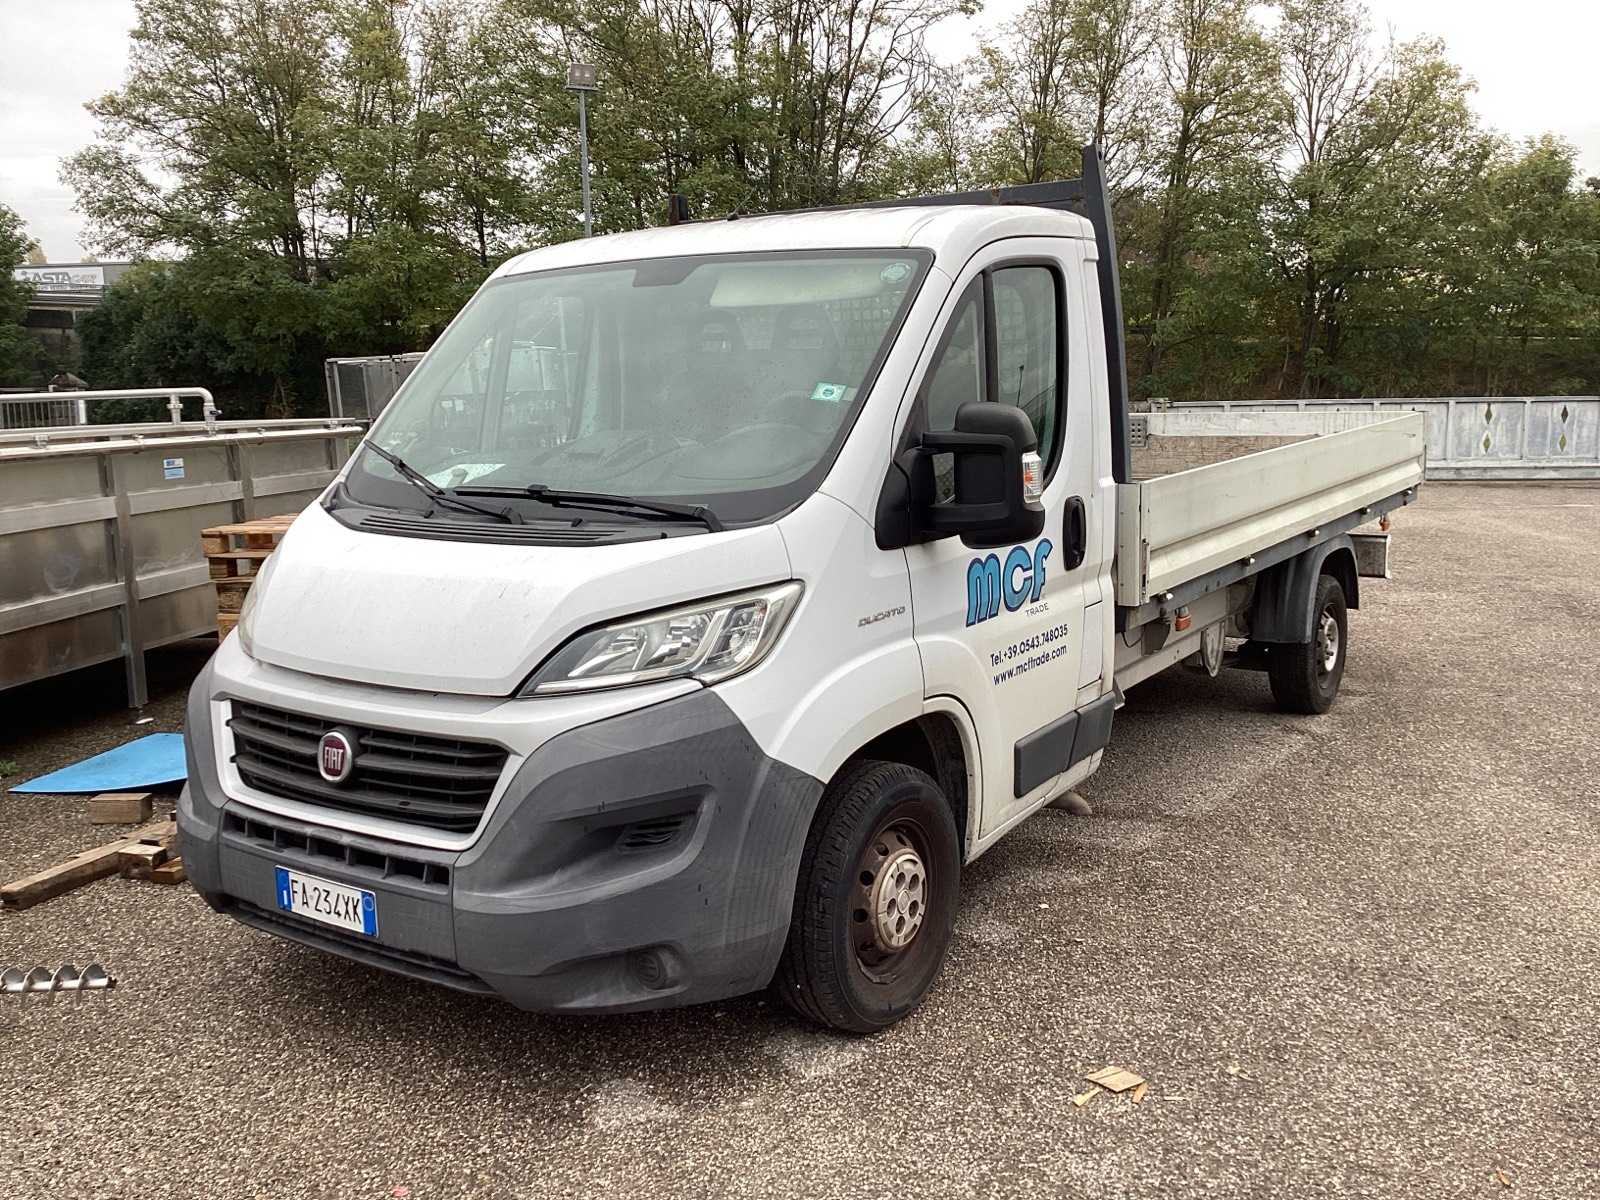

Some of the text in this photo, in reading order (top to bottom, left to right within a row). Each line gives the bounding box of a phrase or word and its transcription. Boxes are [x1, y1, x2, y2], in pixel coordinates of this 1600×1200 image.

[858, 606, 905, 627] DUCATO
[1025, 602, 1049, 616] TRADE
[324, 747, 344, 770] FIAT
